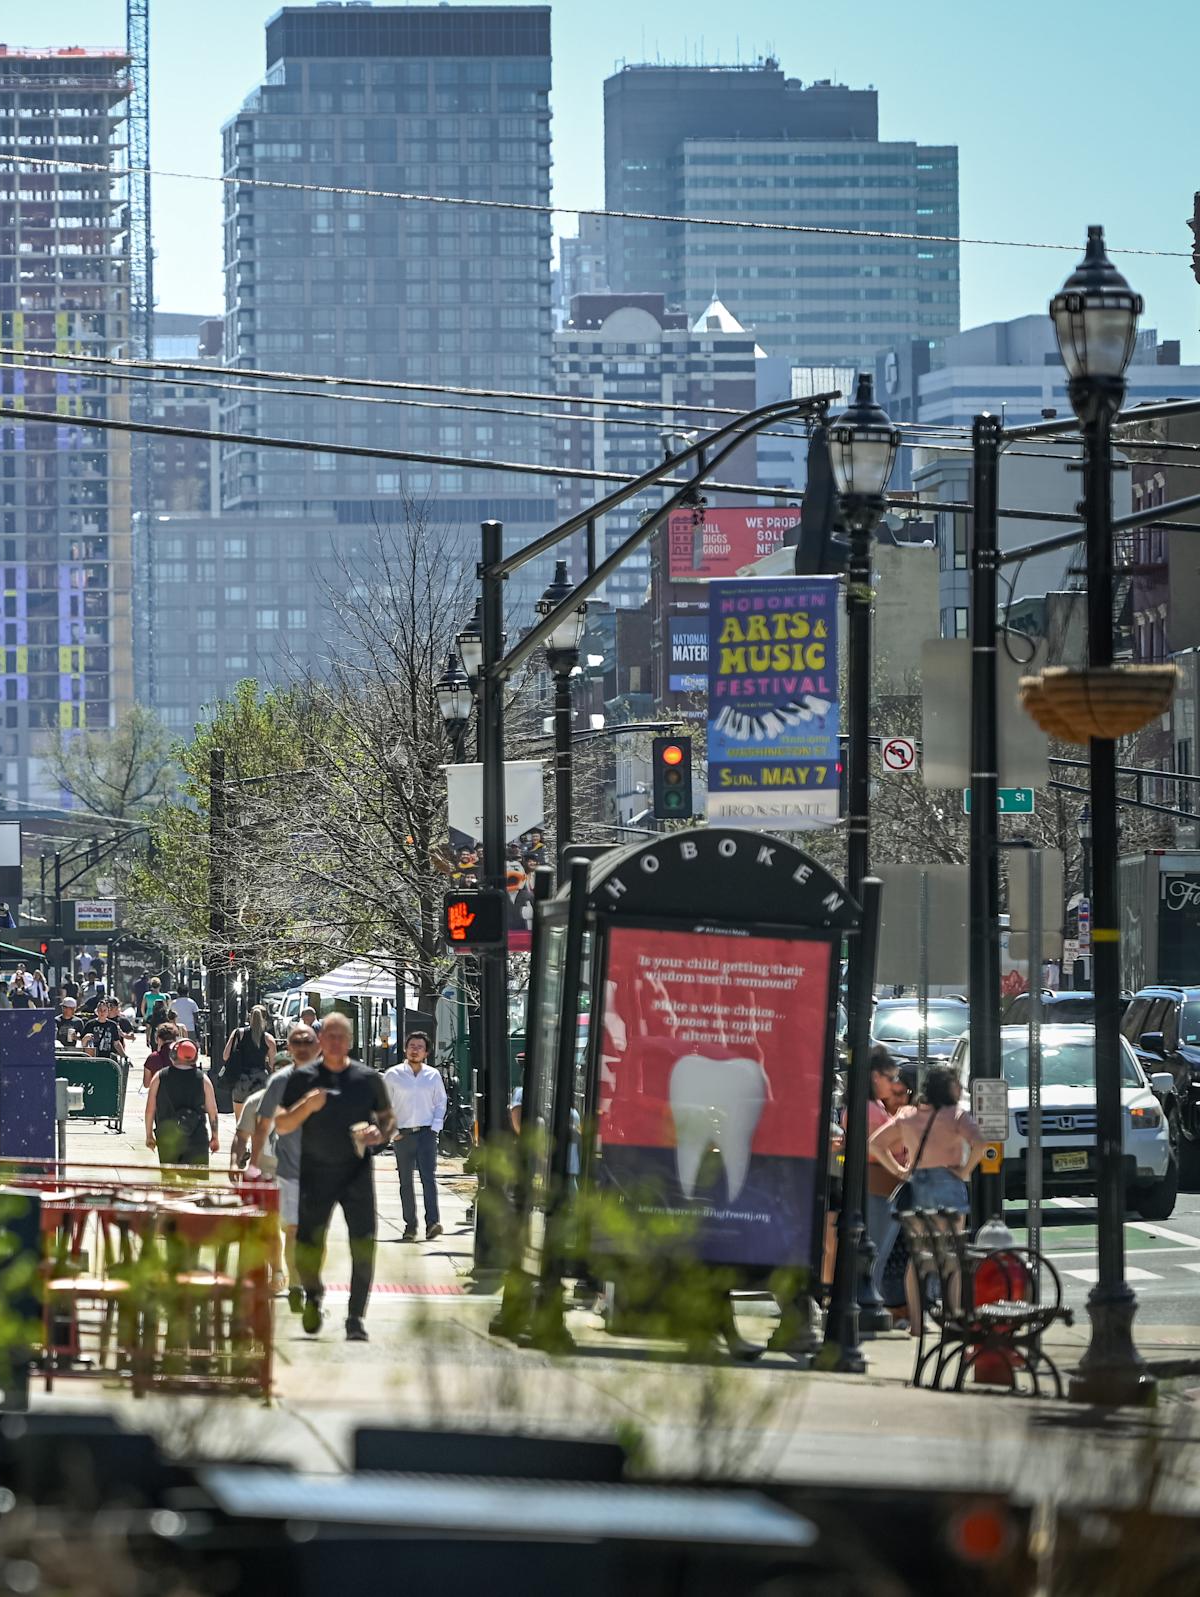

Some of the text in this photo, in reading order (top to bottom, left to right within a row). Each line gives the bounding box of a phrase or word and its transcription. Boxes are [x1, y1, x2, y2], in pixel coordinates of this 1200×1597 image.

[745, 516, 764, 528] WE
[702, 534, 728, 544] BIGGS
[702, 544, 732, 555] GROUP
[721, 593, 827, 612] HOBOKEN
[718, 611, 828, 644] ARTS &
[672, 634, 708, 645] NATIONAL
[719, 642, 826, 674] MUSIC
[715, 676, 831, 697] FESTIVAL
[762, 767, 810, 785] MAY
[815, 766, 828, 785] 7
[1015, 792, 1026, 802] St
[720, 803, 827, 817] IRONSTATE
[604, 838, 845, 913] HOBOKEN
[653, 956, 684, 970] your
[687, 957, 720, 971] child
[722, 961, 768, 976] getting
[770, 964, 806, 977] their
[644, 970, 798, 991] wisdom teeth removed?
[653, 999, 786, 1019] Make a wise choice...
[666, 1016, 773, 1034] choose an opioid
